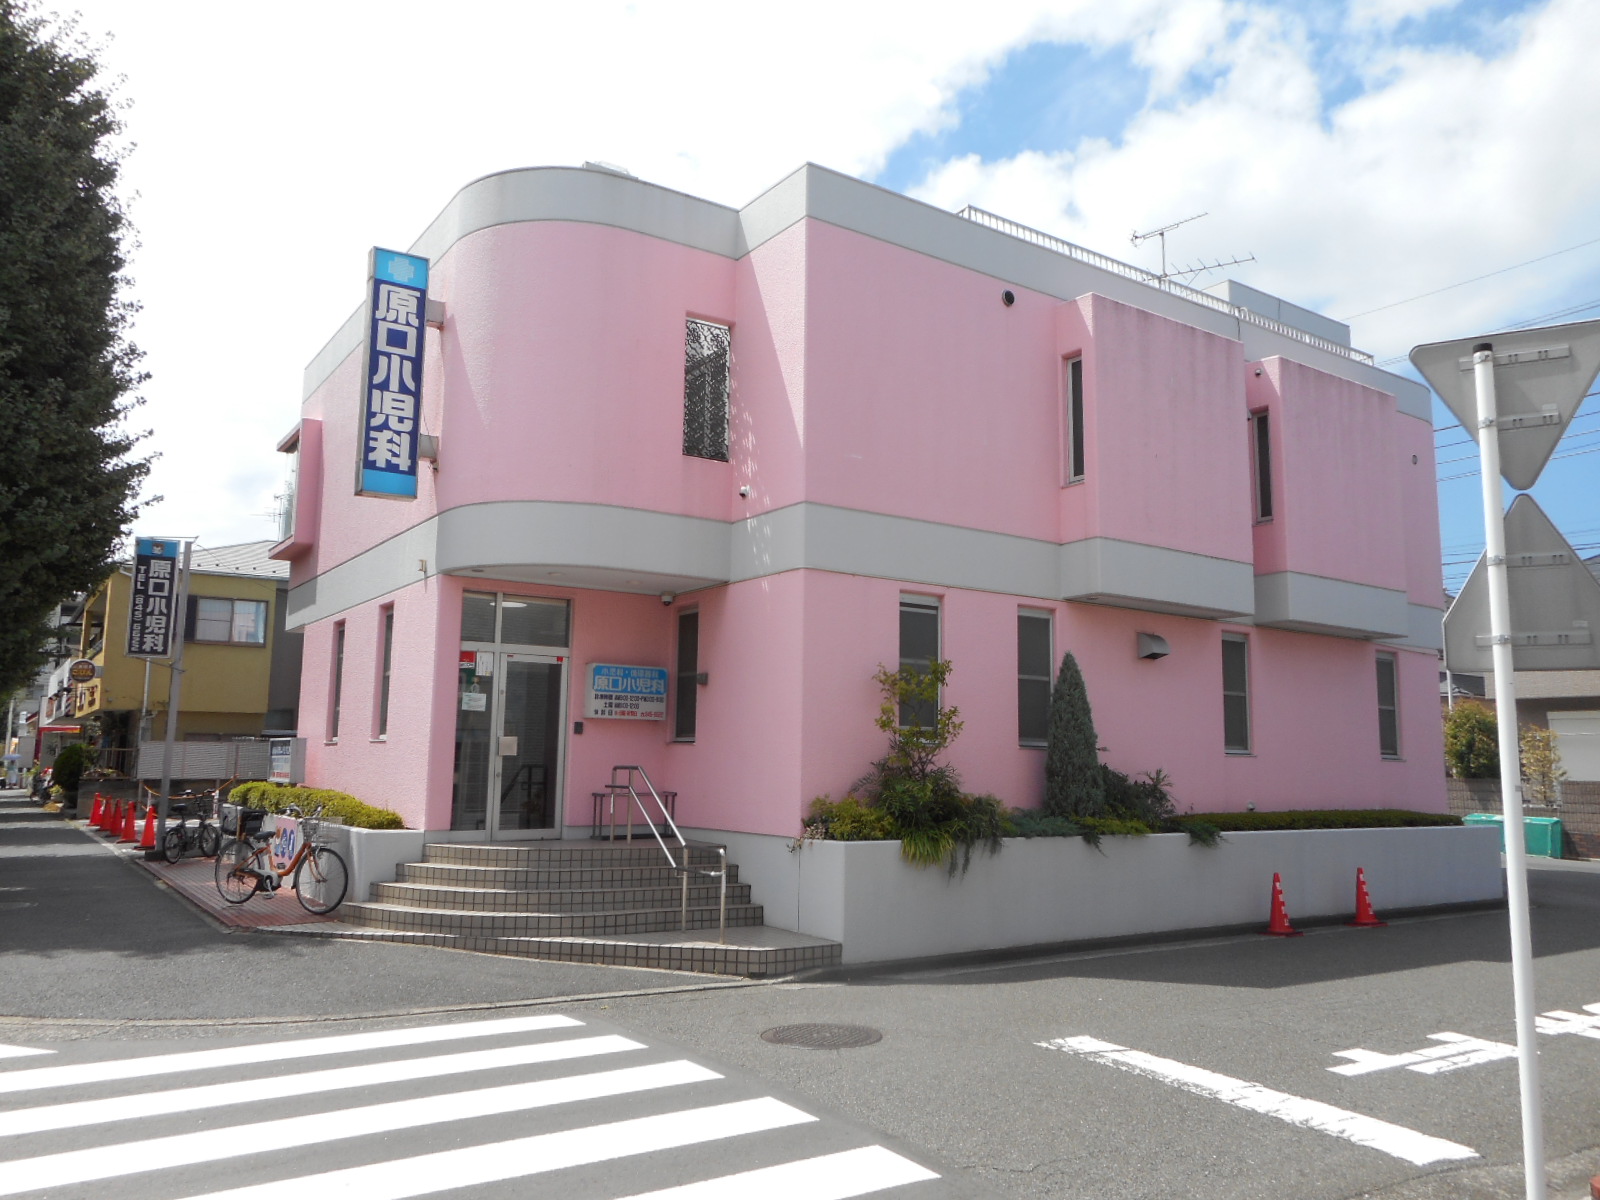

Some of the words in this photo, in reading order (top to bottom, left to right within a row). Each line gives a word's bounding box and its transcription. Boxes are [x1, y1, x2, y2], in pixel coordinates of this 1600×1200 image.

[367, 283, 421, 472] 原口小児科
[136, 565, 148, 590] TEL
[142, 559, 172, 653] 原口小児科
[593, 675, 665, 693] 原口小児科
